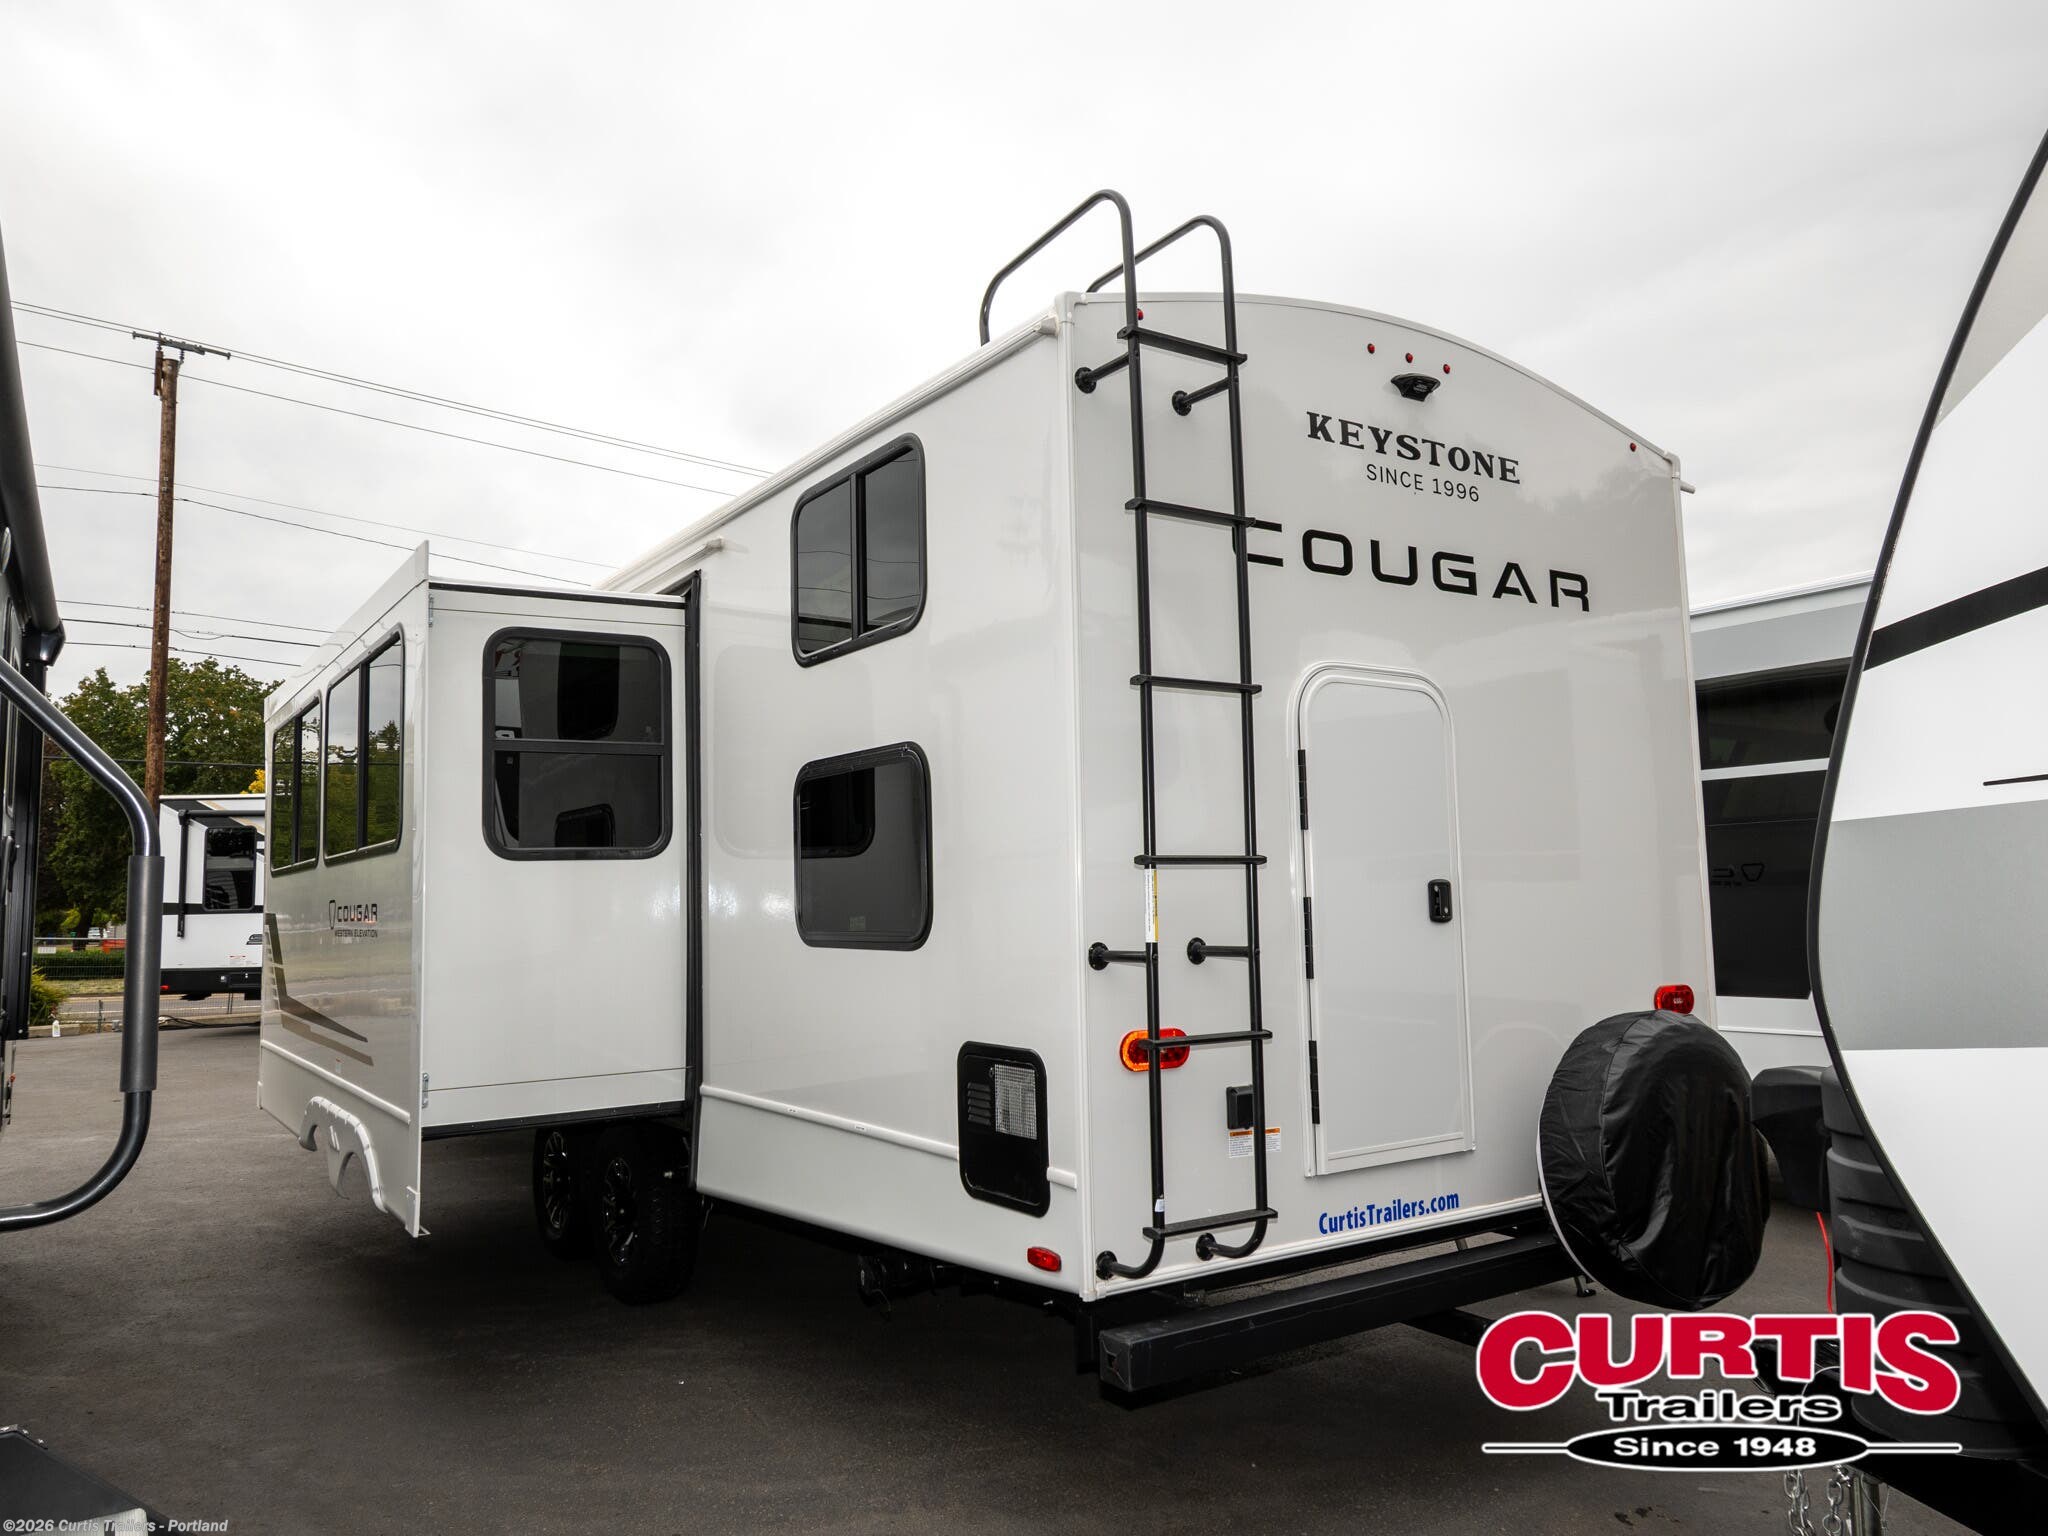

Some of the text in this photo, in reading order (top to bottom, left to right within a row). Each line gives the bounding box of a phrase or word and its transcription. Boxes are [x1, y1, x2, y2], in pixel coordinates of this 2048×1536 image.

[1306, 411, 1520, 484] KEYSTONE
[1366, 463, 1480, 502] SINCE 1996
[336, 903, 378, 922] COUGAR
[1319, 1193, 1459, 1234] CurtisTrailers.com
